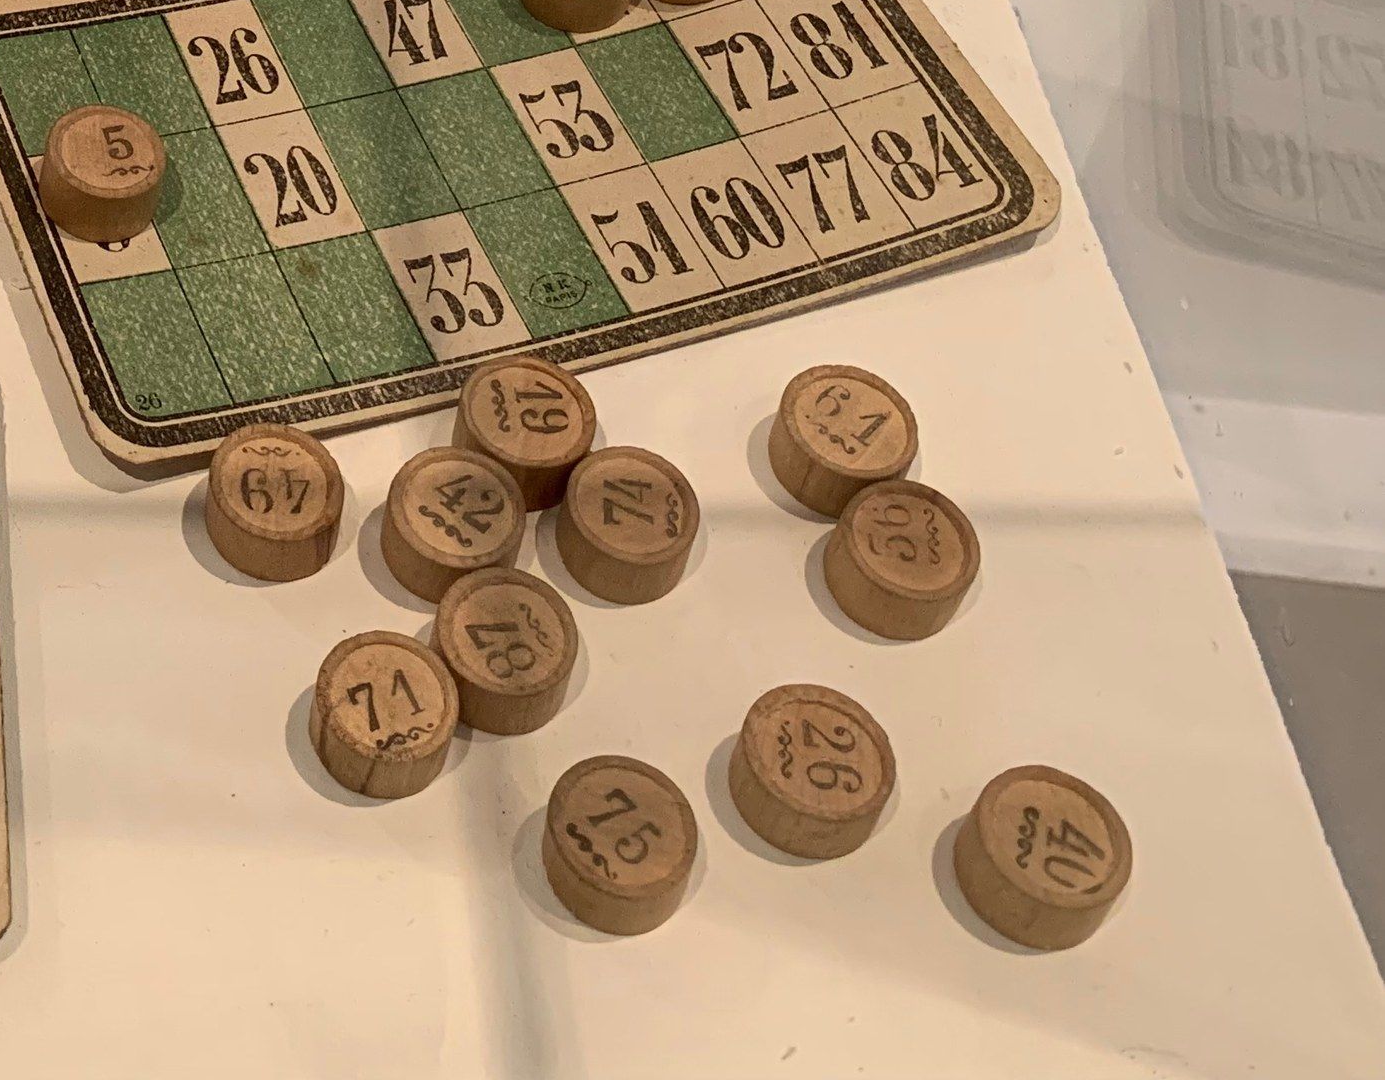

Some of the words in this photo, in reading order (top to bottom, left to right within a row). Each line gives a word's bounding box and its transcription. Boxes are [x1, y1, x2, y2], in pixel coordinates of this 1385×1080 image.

[187, 27, 280, 105] 26
[695, 31, 799, 111] 72
[789, 0, 889, 80] 81
[101, 124, 134, 160] 5
[519, 80, 615, 159] 53
[871, 114, 983, 201] 84
[244, 145, 338, 228] 20
[690, 177, 786, 260] 60
[776, 145, 871, 235] 77
[590, 200, 694, 284] 51
[404, 248, 506, 335] 33
[134, 393, 164, 412] 26
[515, 380, 570, 435] 19
[434, 473, 505, 535] 42
[346, 668, 426, 733] 71
[802, 719, 864, 795] 26
[587, 788, 663, 865] 75
